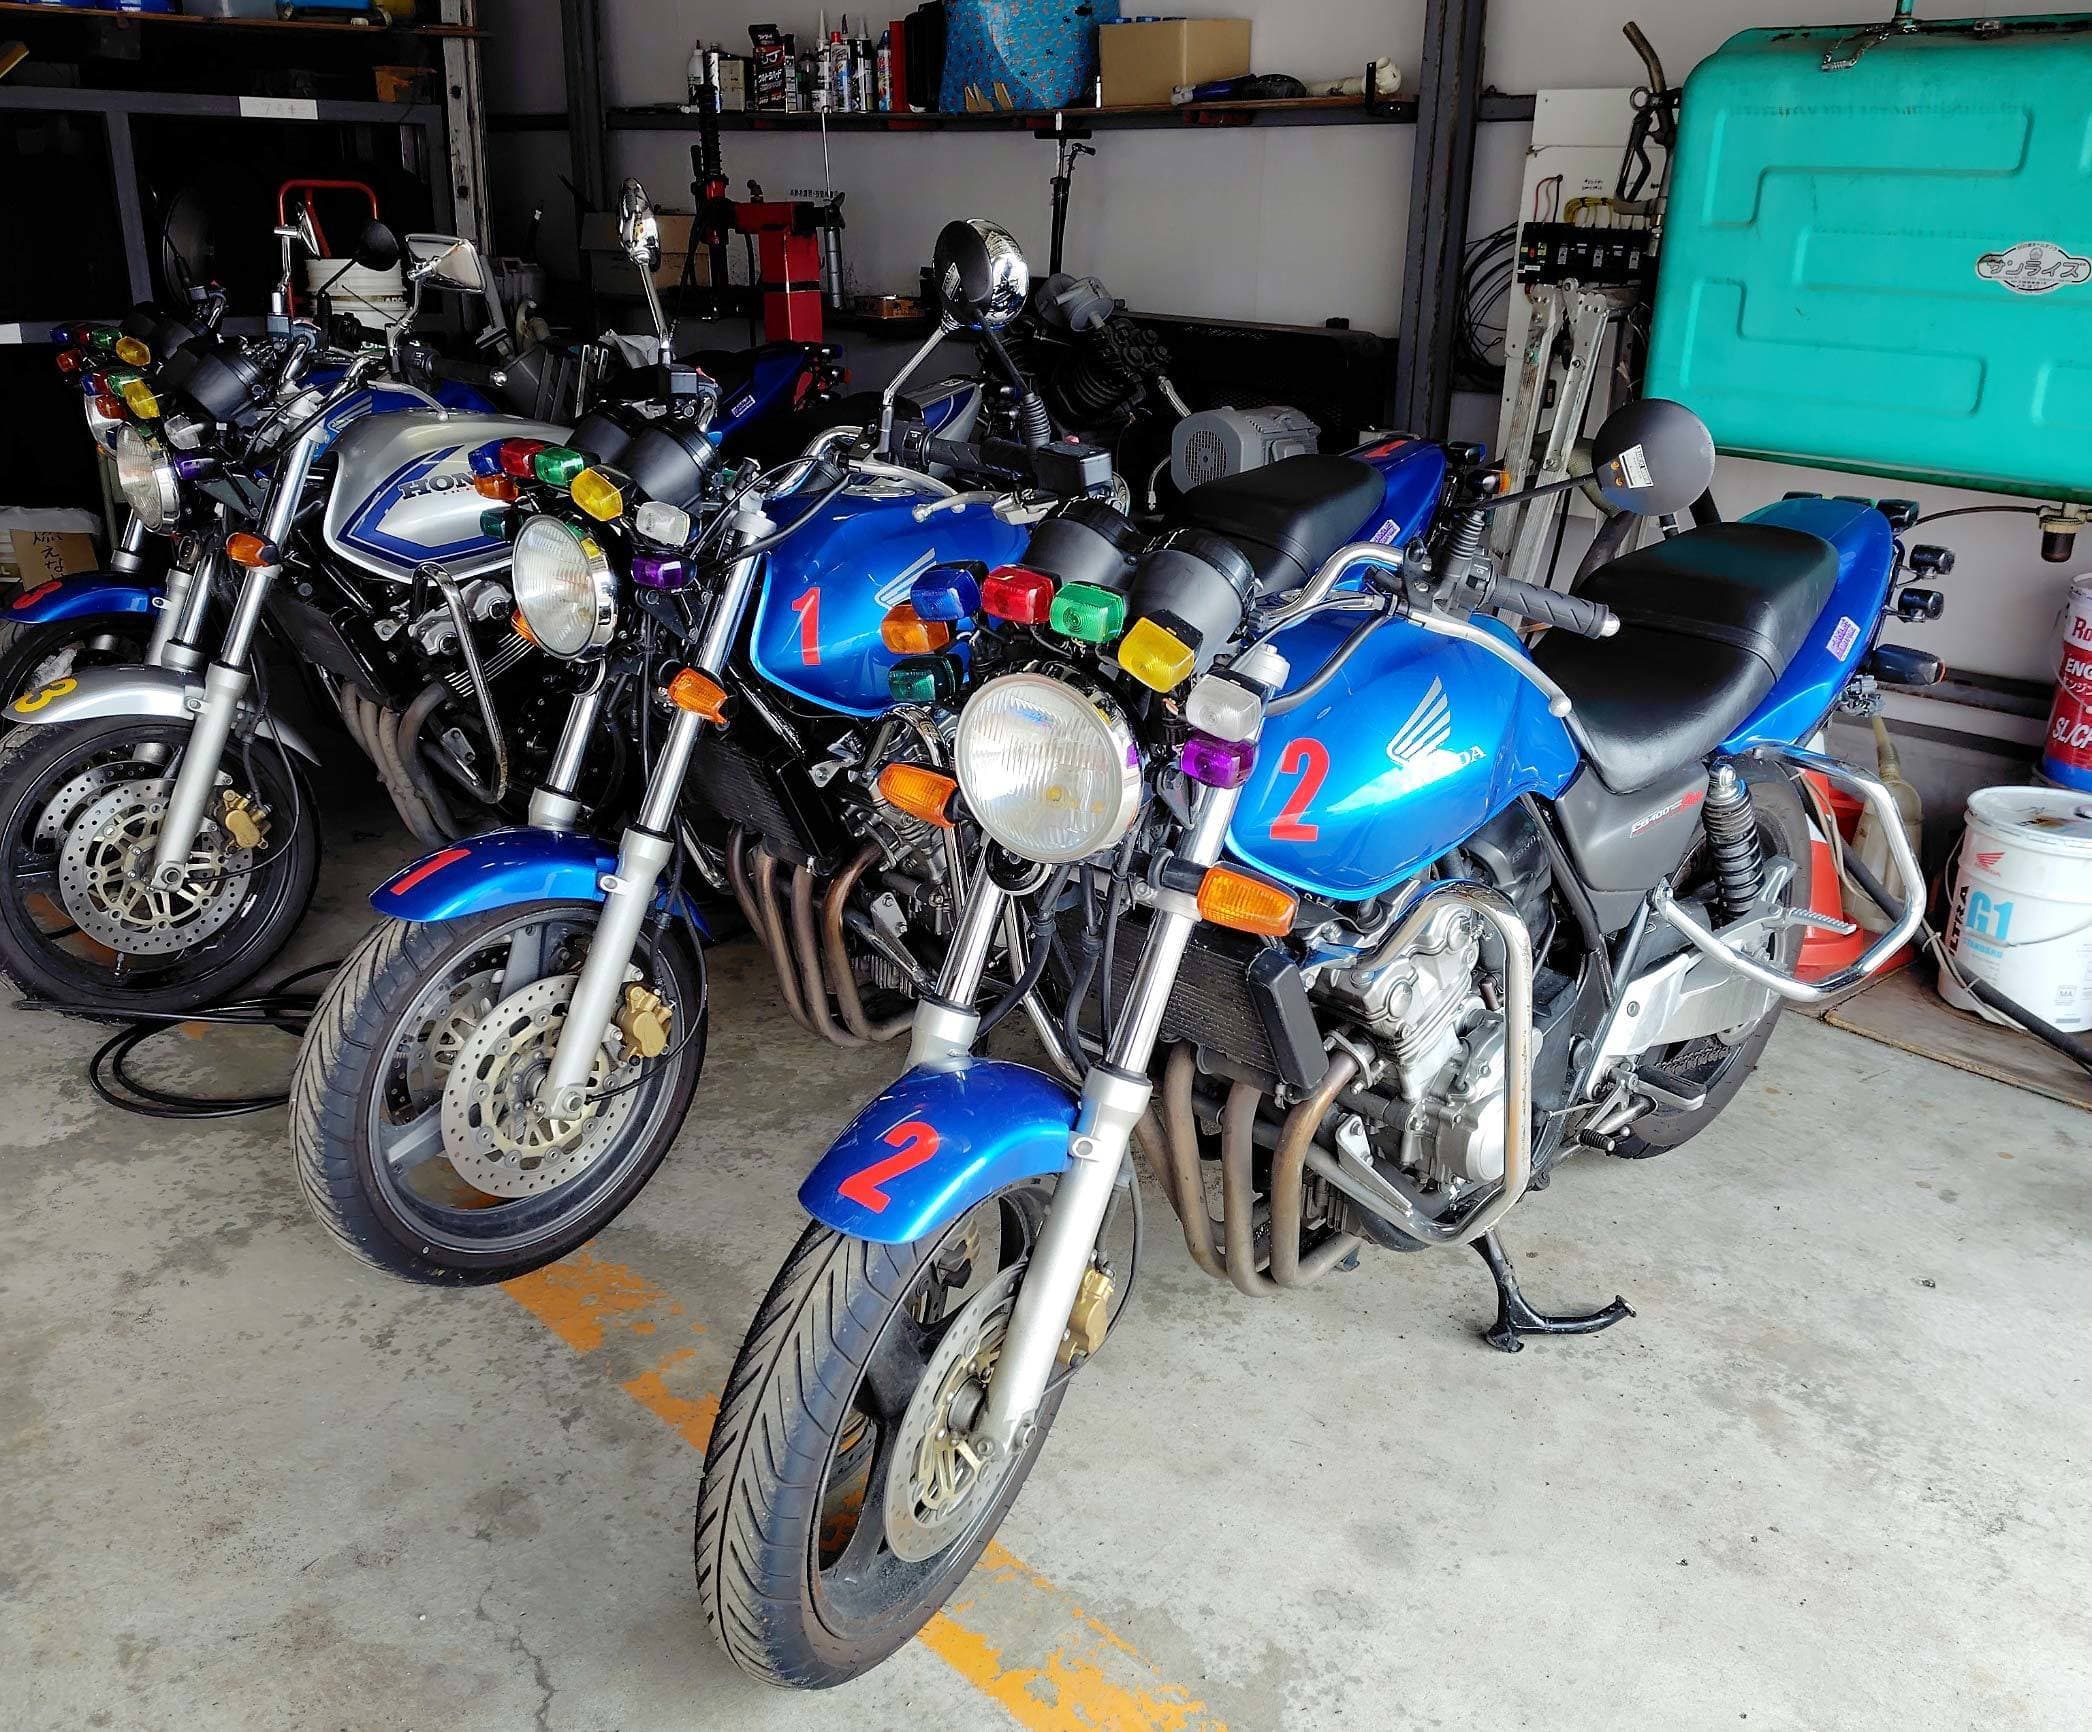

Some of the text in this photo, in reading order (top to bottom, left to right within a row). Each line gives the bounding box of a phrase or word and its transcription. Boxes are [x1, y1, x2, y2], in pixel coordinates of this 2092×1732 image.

[398, 471, 475, 500] HON
[791, 586, 821, 666] 1
[14, 677, 78, 713] 3
[1269, 737, 1331, 842] 2
[390, 848, 472, 896] 1
[837, 1120, 940, 1214] 2
